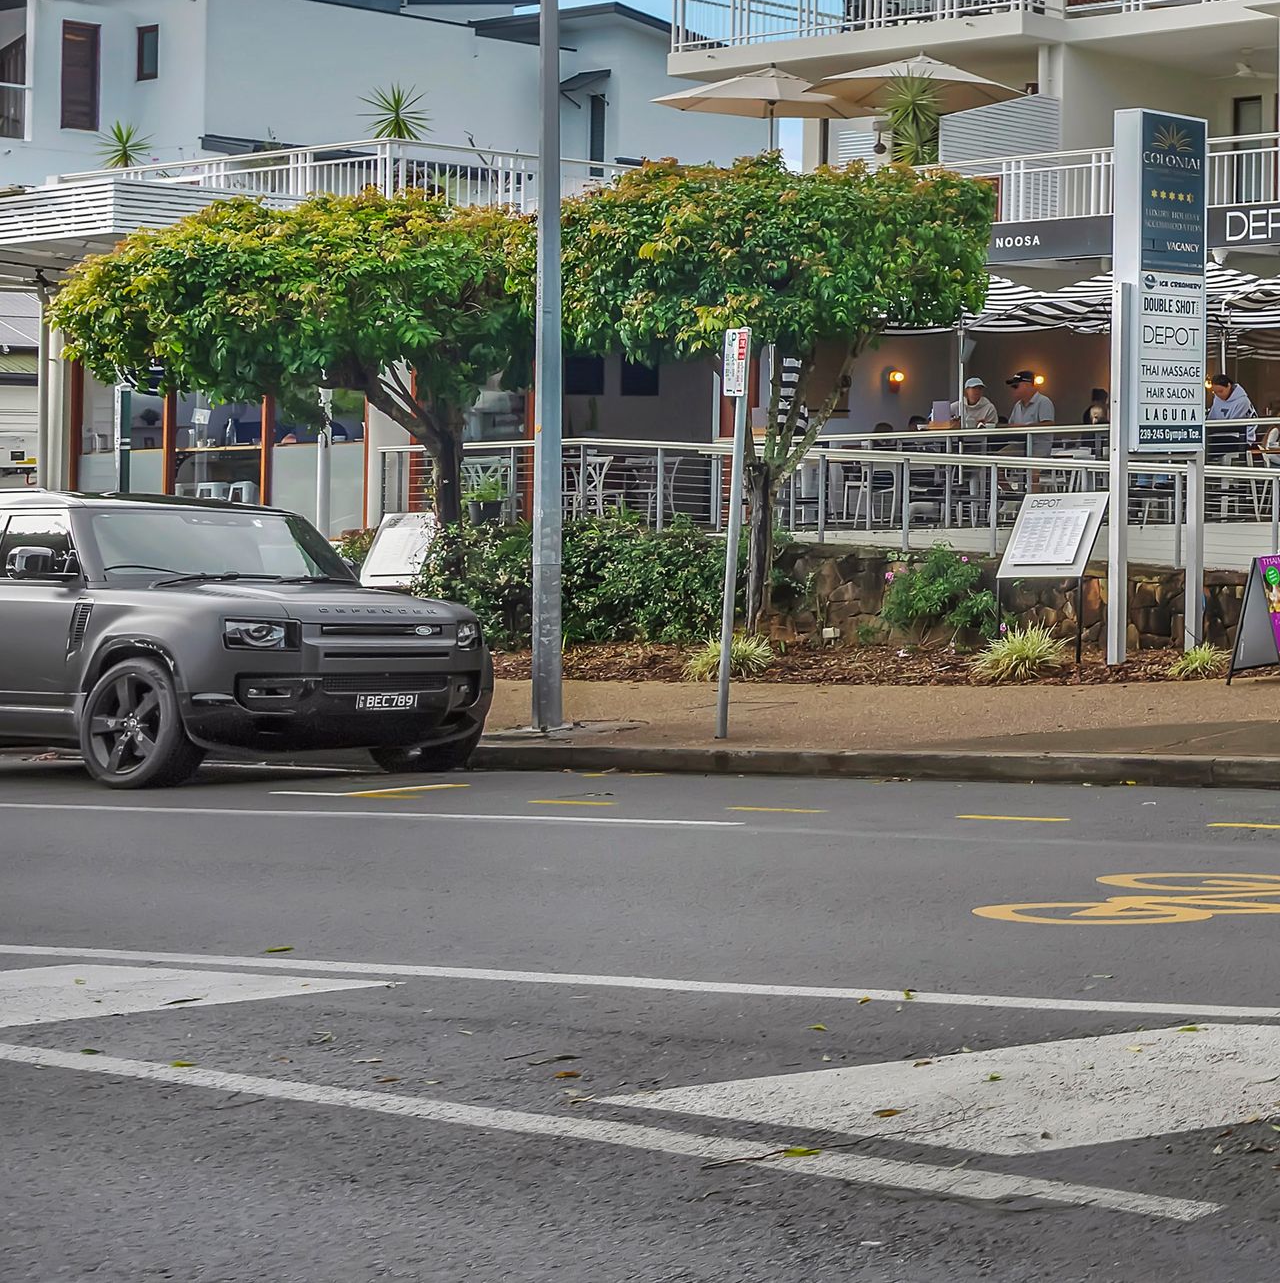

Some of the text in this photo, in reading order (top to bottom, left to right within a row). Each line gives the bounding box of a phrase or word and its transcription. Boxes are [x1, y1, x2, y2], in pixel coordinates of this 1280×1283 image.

[995, 235, 1041, 249] NOOSA
[1167, 241, 1199, 253] VACANCY
[1143, 297, 1173, 314] DOUBLE
[1175, 299, 1196, 315] SHOT
[1143, 325, 1200, 346] DEPOT
[1141, 364, 1201, 378] THAI MASSAGE
[1146, 387, 1195, 399] HAIR SALON
[1145, 408, 1197, 422] LAGUNA
[1140, 428, 1201, 442] 239-245 Gympie Tce.
[1030, 498, 1063, 509] DEPOT
[318, 607, 438, 615] DEFENDER
[366, 695, 414, 707] BEC789
